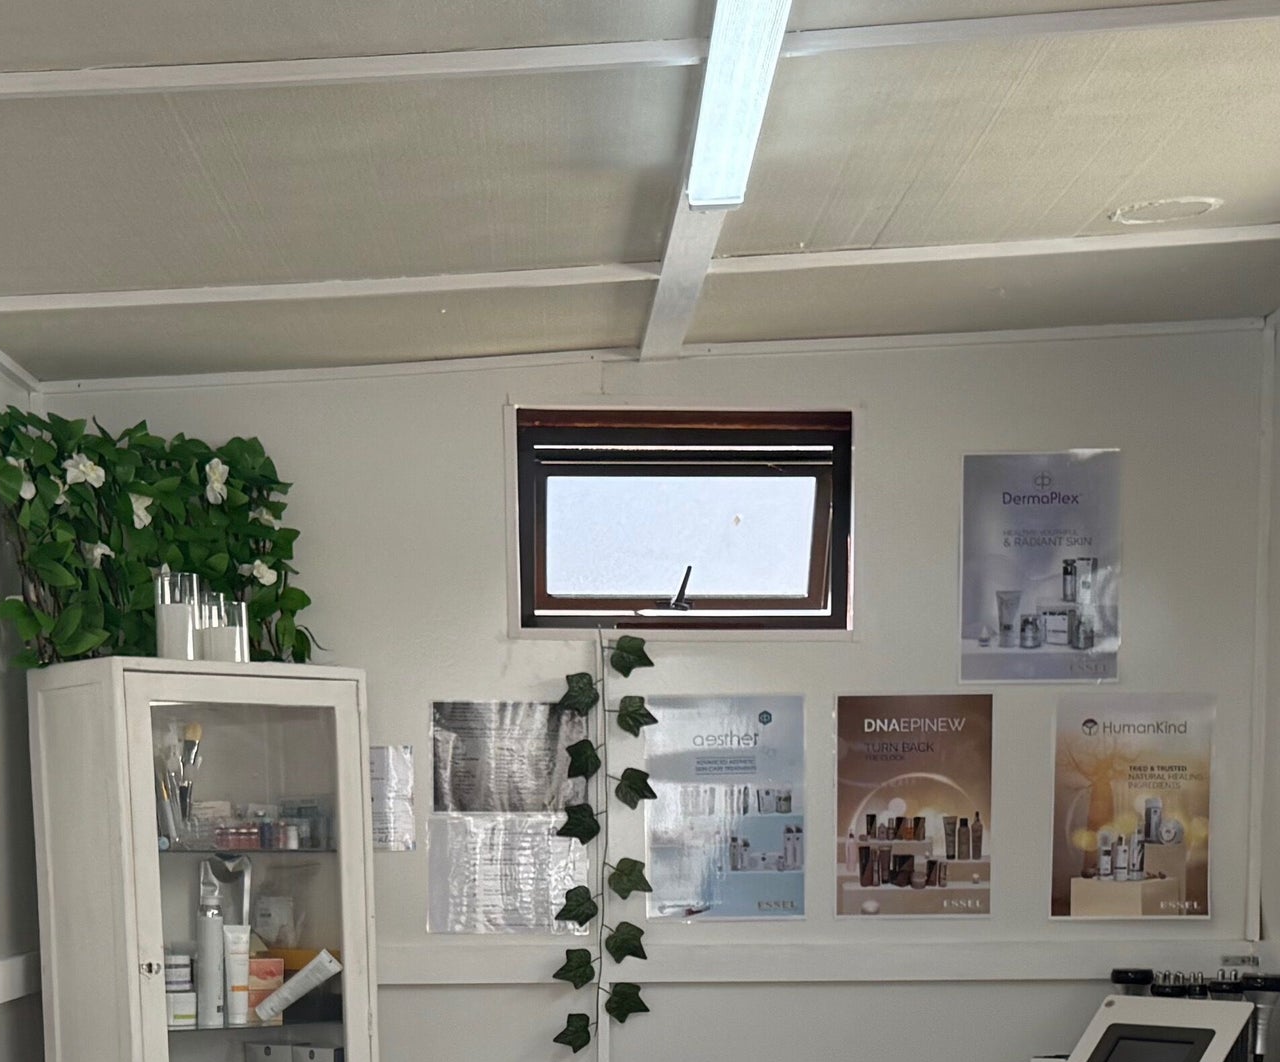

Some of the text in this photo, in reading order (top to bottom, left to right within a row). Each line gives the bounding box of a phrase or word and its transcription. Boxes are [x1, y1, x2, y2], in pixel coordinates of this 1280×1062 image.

[1002, 492, 1079, 505] DermaPlex
[1003, 537, 1093, 547] & RADIANT SKIN
[864, 718, 966, 733] DNAEPINEW
[1102, 721, 1188, 737] HumanKind
[865, 742, 935, 753] TURN BACK
